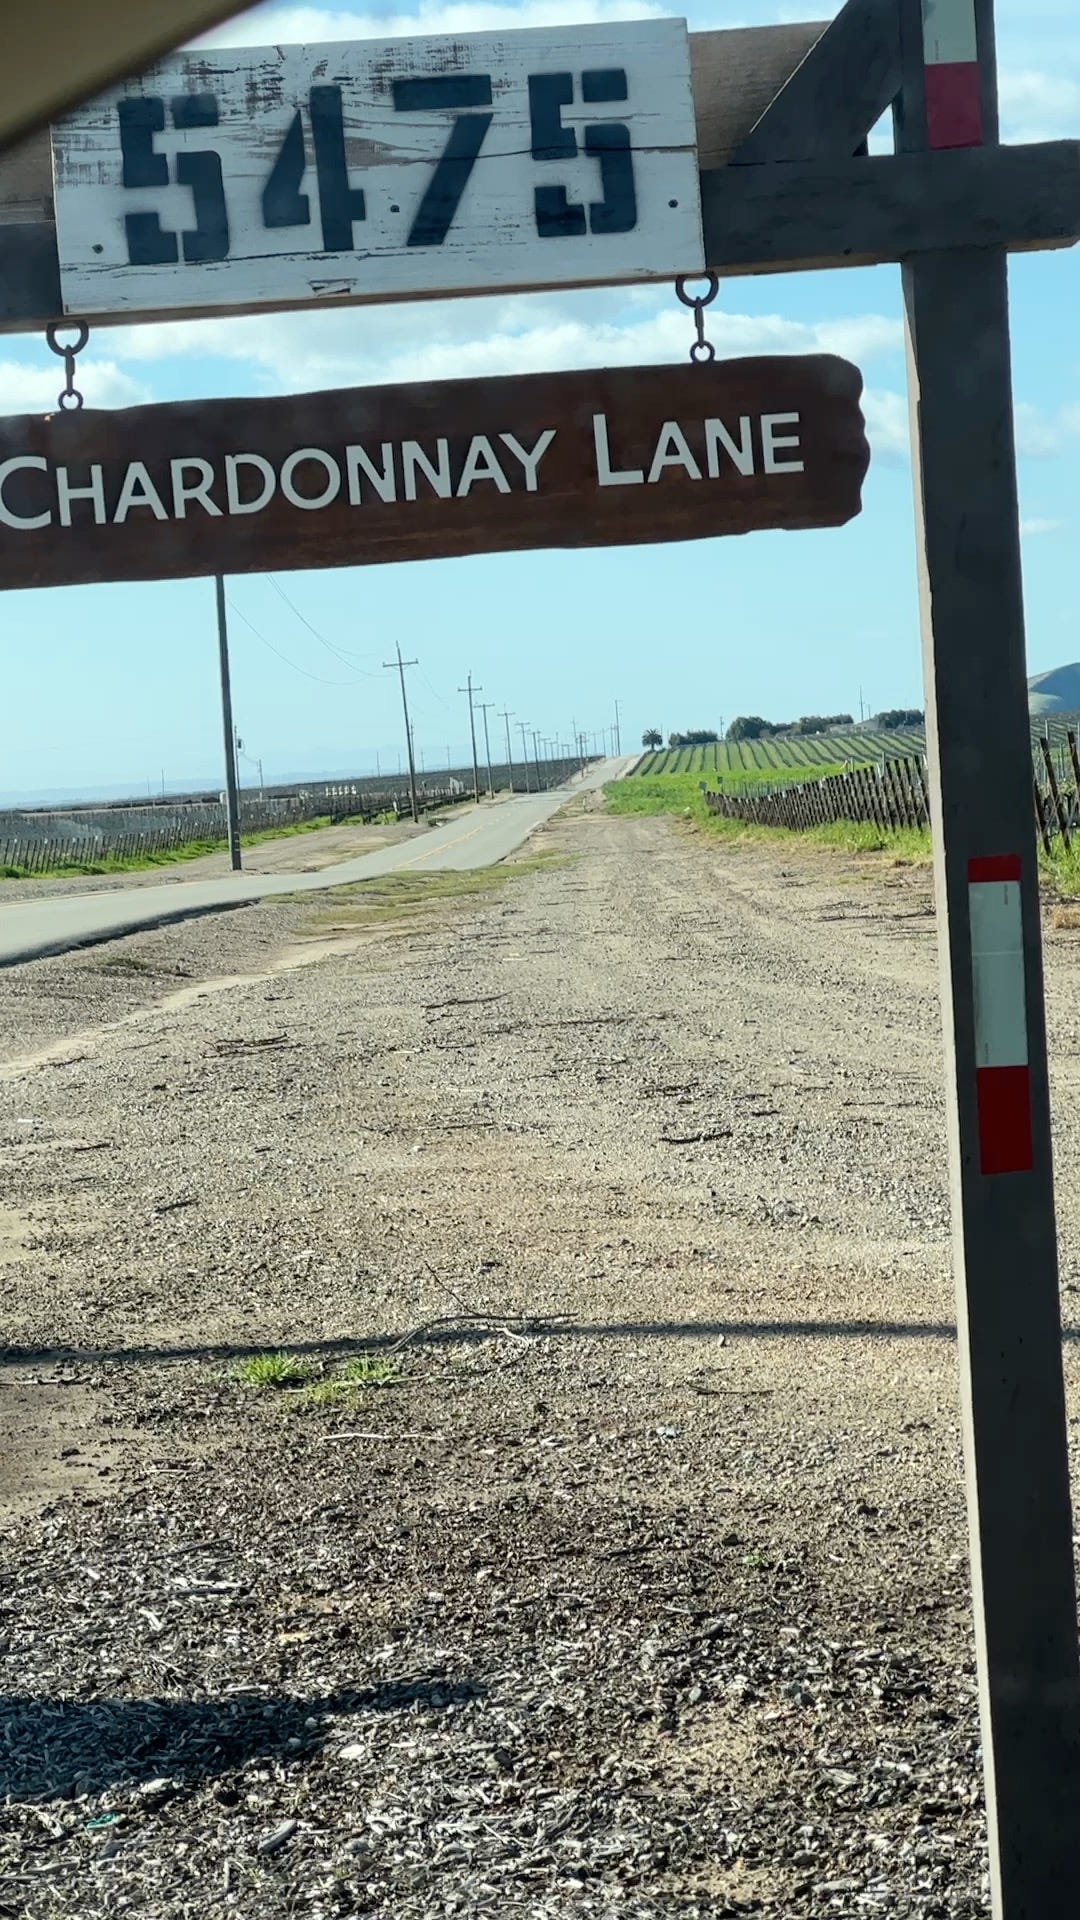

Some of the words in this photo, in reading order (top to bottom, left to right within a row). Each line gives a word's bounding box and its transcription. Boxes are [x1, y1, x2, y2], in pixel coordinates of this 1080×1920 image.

[118, 68, 637, 266] 5475
[0, 430, 556, 529] CHARDONNAY
[593, 412, 804, 486] LANE
